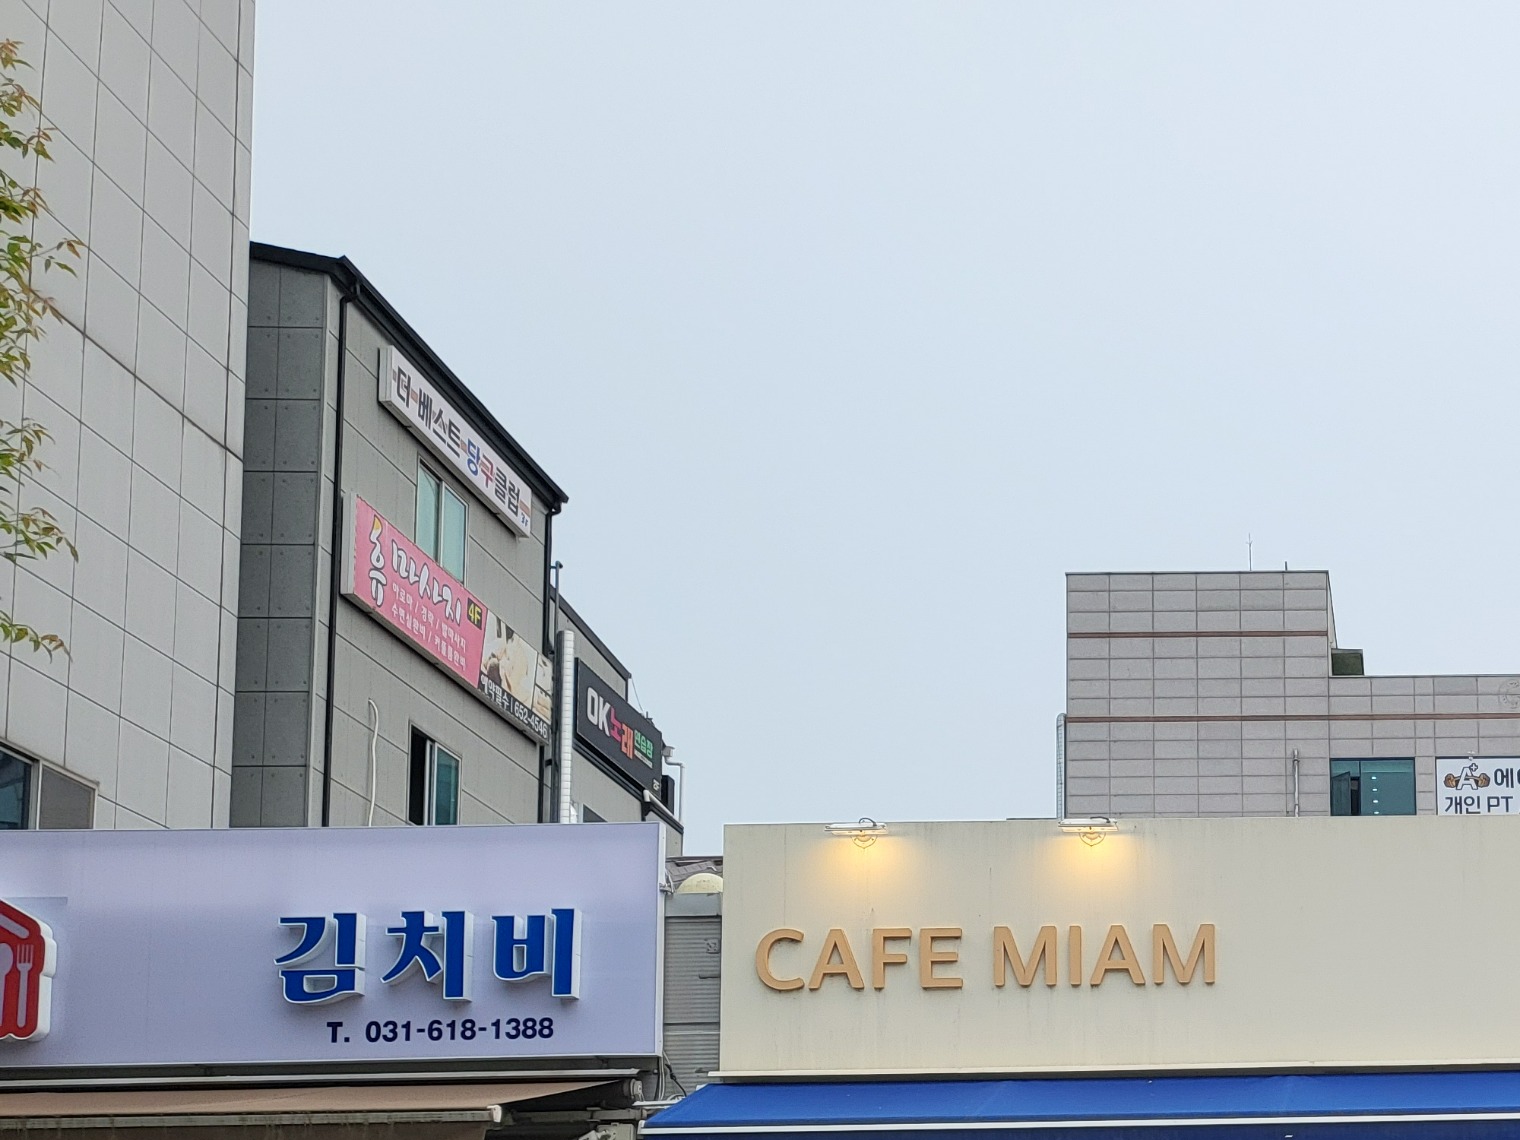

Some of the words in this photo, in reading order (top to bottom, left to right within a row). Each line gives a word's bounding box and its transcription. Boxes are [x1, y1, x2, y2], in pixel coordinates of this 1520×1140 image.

[418, 387, 461, 458] 베스트
[467, 437, 520, 517] 당구클럽
[391, 539, 462, 626] 마사지
[468, 600, 481, 626] 4F
[480, 674, 509, 710] 예약필수
[514, 702, 548, 739] 652-4546
[1445, 795, 1481, 815] 개인
[1487, 796, 1513, 813] PT
[273, 908, 582, 1004] 김치비
[755, 926, 964, 991] CAFE
[993, 923, 1217, 987] MIAM
[326, 1021, 351, 1044] T.
[364, 1017, 555, 1043] 031-618-1388
